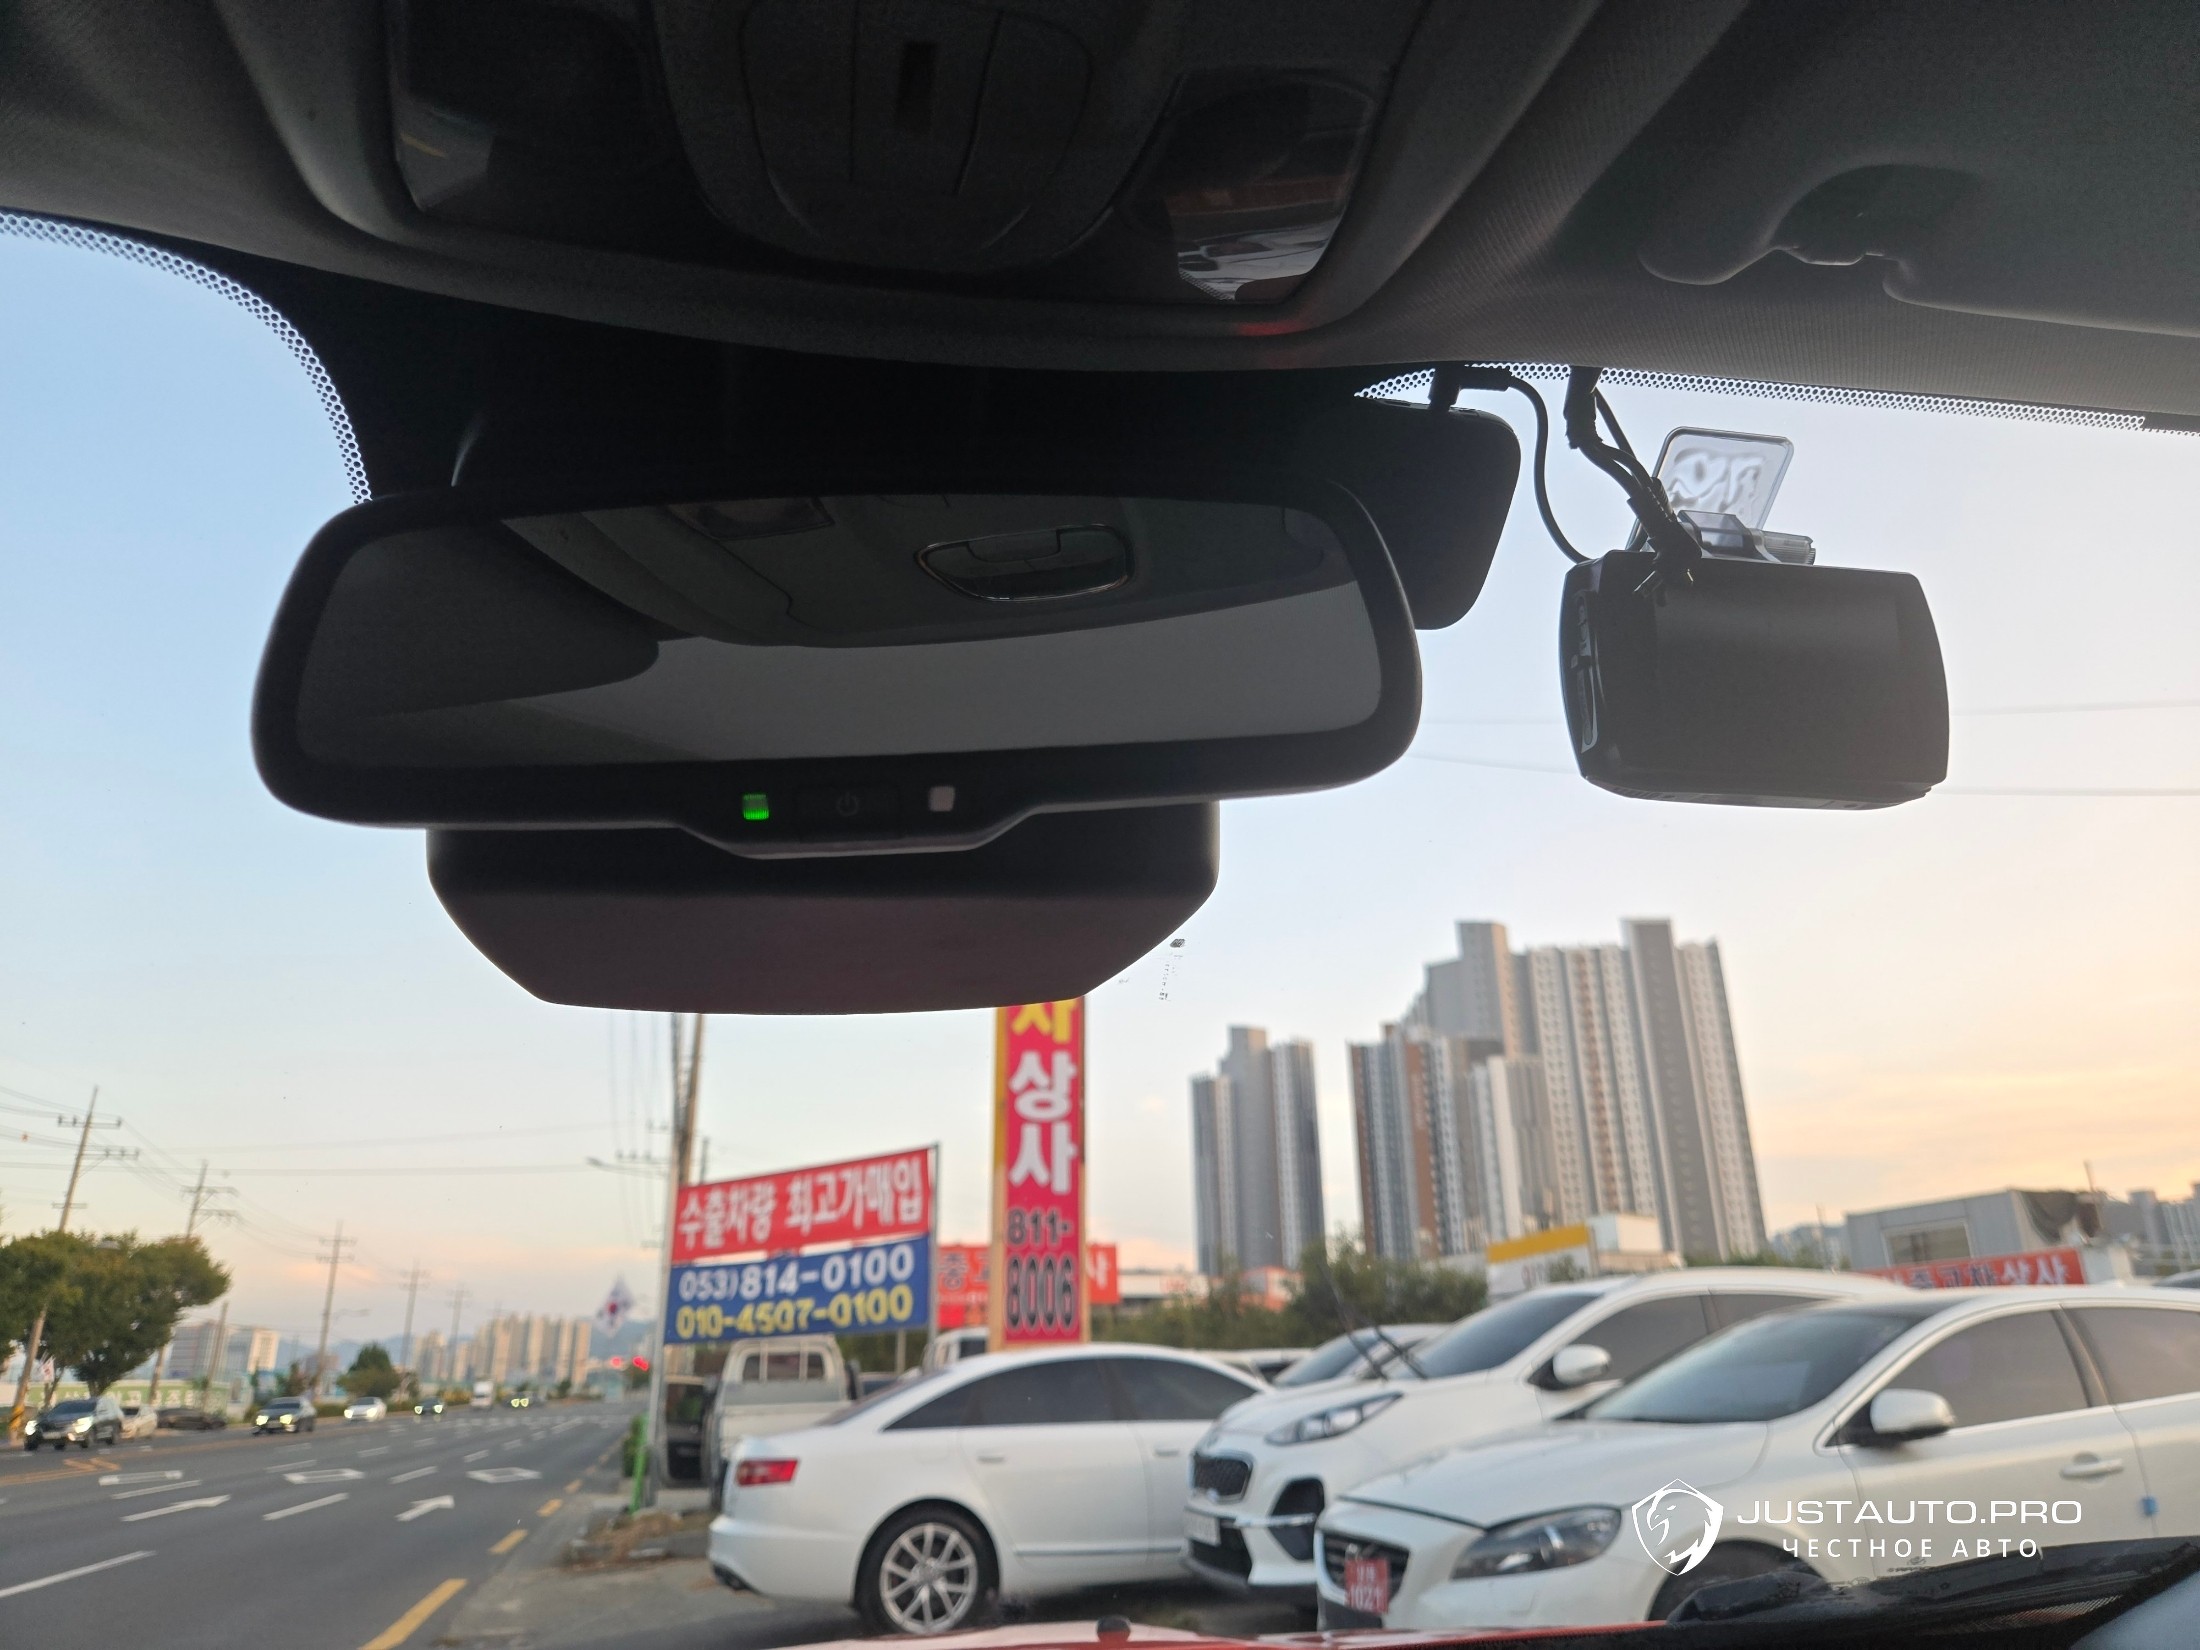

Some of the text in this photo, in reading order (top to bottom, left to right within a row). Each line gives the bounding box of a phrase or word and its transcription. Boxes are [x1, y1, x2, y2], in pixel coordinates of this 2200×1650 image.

[678, 1158, 924, 1249] 수출차량 최고가매입
[678, 1243, 915, 1301] 053)814-0100
[1004, 1253, 1076, 1331] 8006
[676, 1283, 914, 1340] 010-4507-0100
